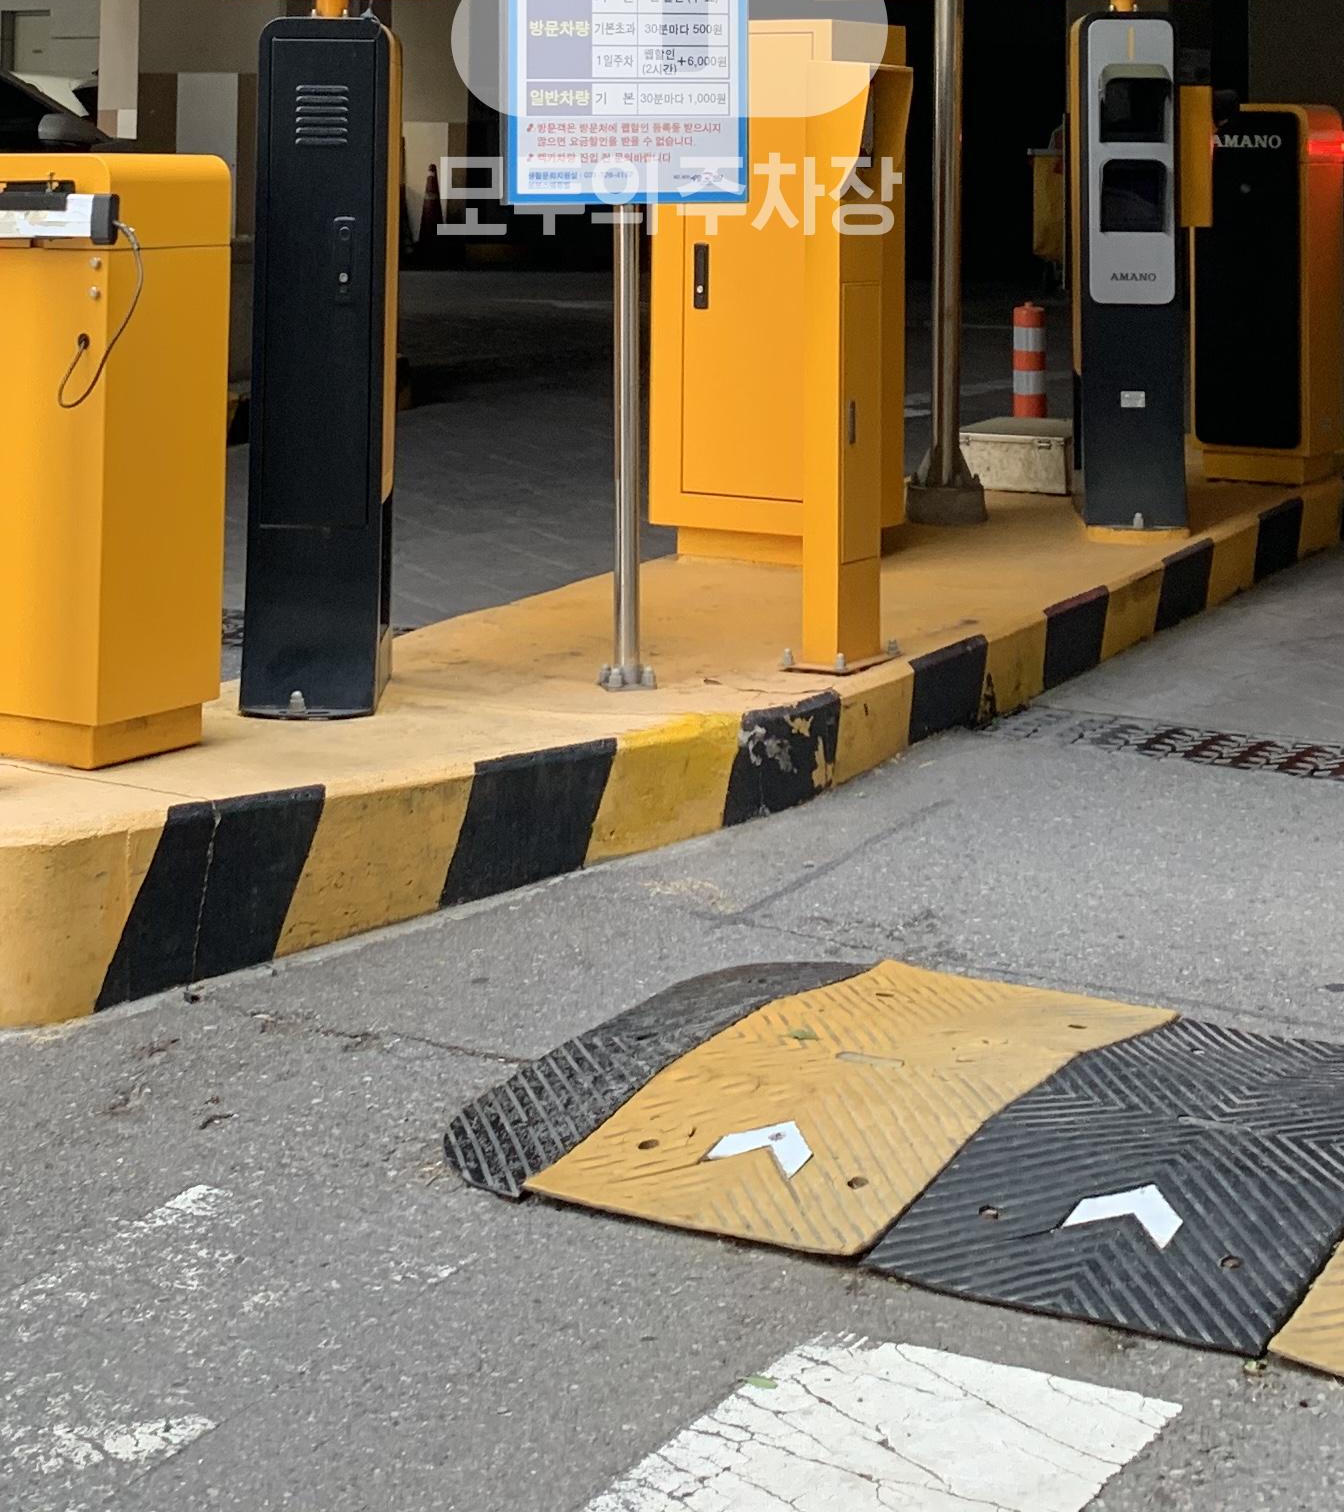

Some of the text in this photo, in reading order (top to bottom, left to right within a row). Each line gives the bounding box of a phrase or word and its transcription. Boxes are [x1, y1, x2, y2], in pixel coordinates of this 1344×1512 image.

[529, 20, 723, 37] 방문차량 기본초과 30분마다 500원
[596, 54, 634, 68] 1일주차
[529, 89, 590, 107] 일반차량
[640, 92, 684, 105] 30분마다
[688, 92, 727, 105] 1,000원
[1212, 134, 1282, 150] AMANO
[1110, 272, 1157, 282] AMANO
